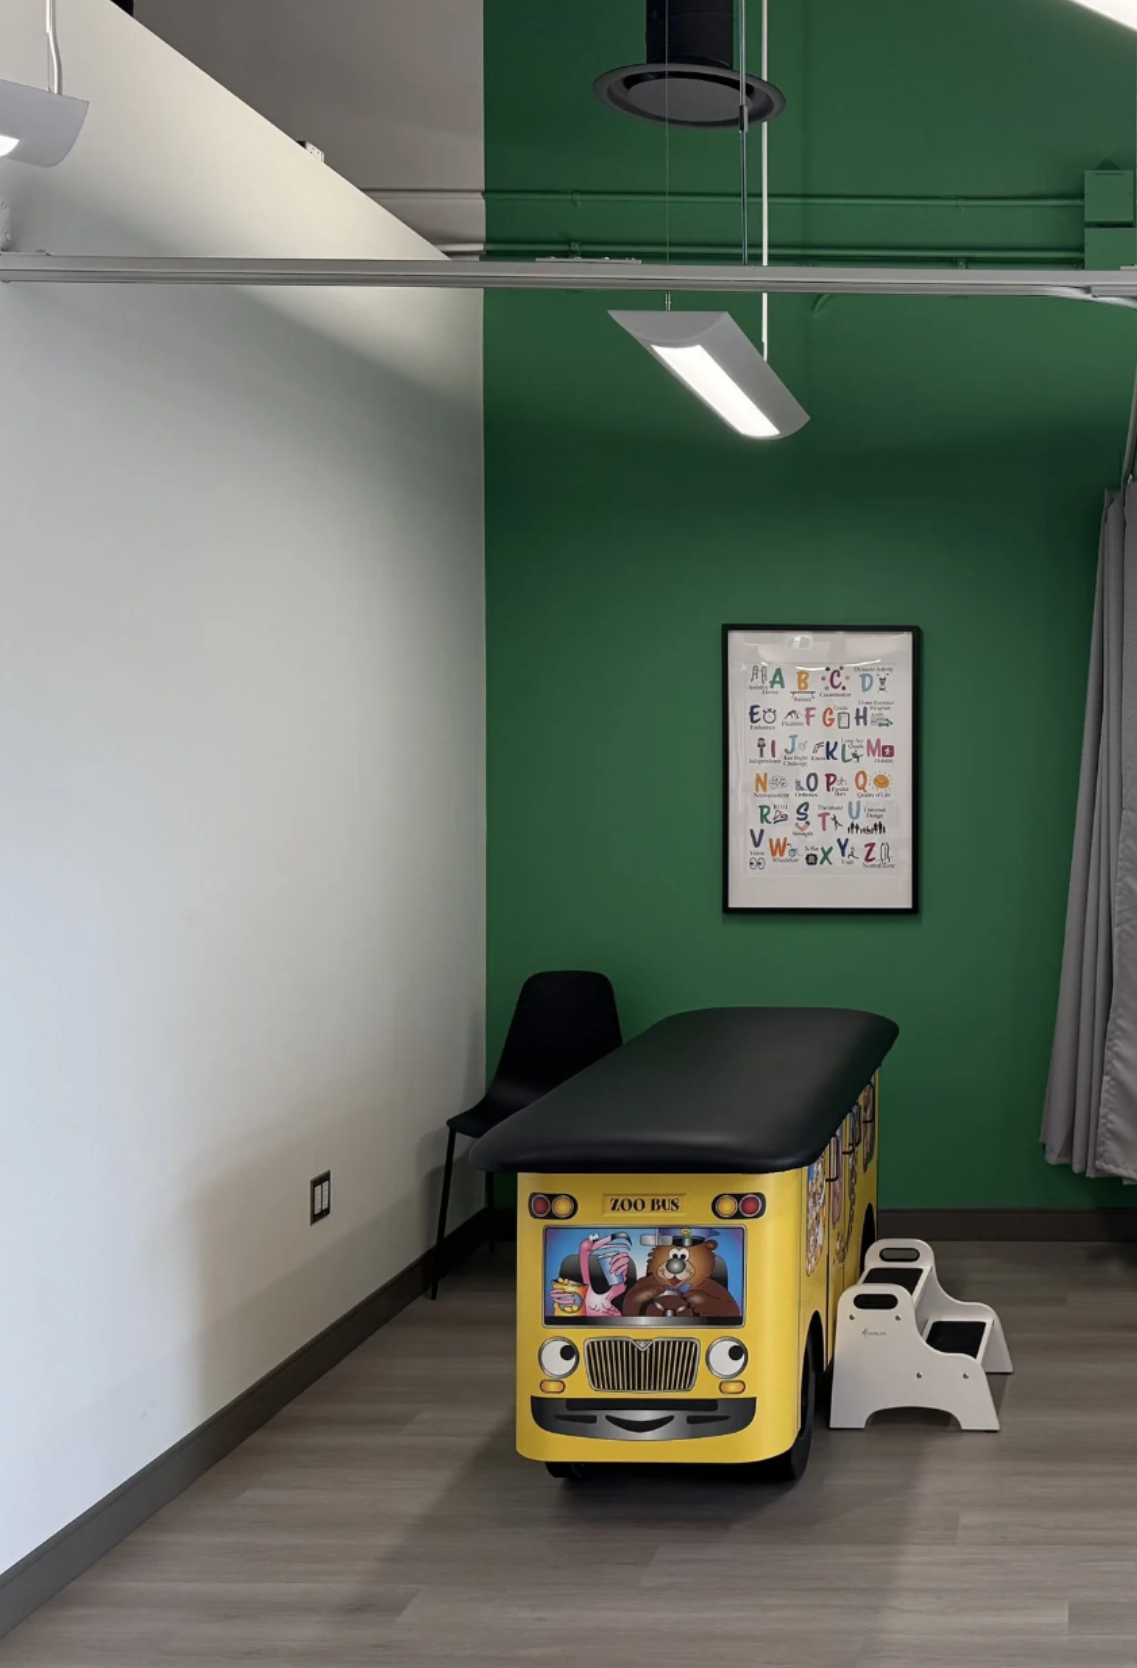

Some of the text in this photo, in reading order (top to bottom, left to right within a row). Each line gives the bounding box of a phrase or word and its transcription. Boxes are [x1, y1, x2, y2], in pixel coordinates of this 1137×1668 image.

[769, 668, 874, 693] A B C D
[748, 704, 868, 728] E F G H
[784, 734, 798, 754] J
[825, 740, 838, 761] K
[841, 743, 852, 763] L
[866, 738, 881, 757] M
[755, 770, 867, 793] N O P Q
[758, 801, 860, 832] R S T U
[749, 828, 876, 866] V W X Y Z
[610, 1197, 680, 1212] ZOO BUS
